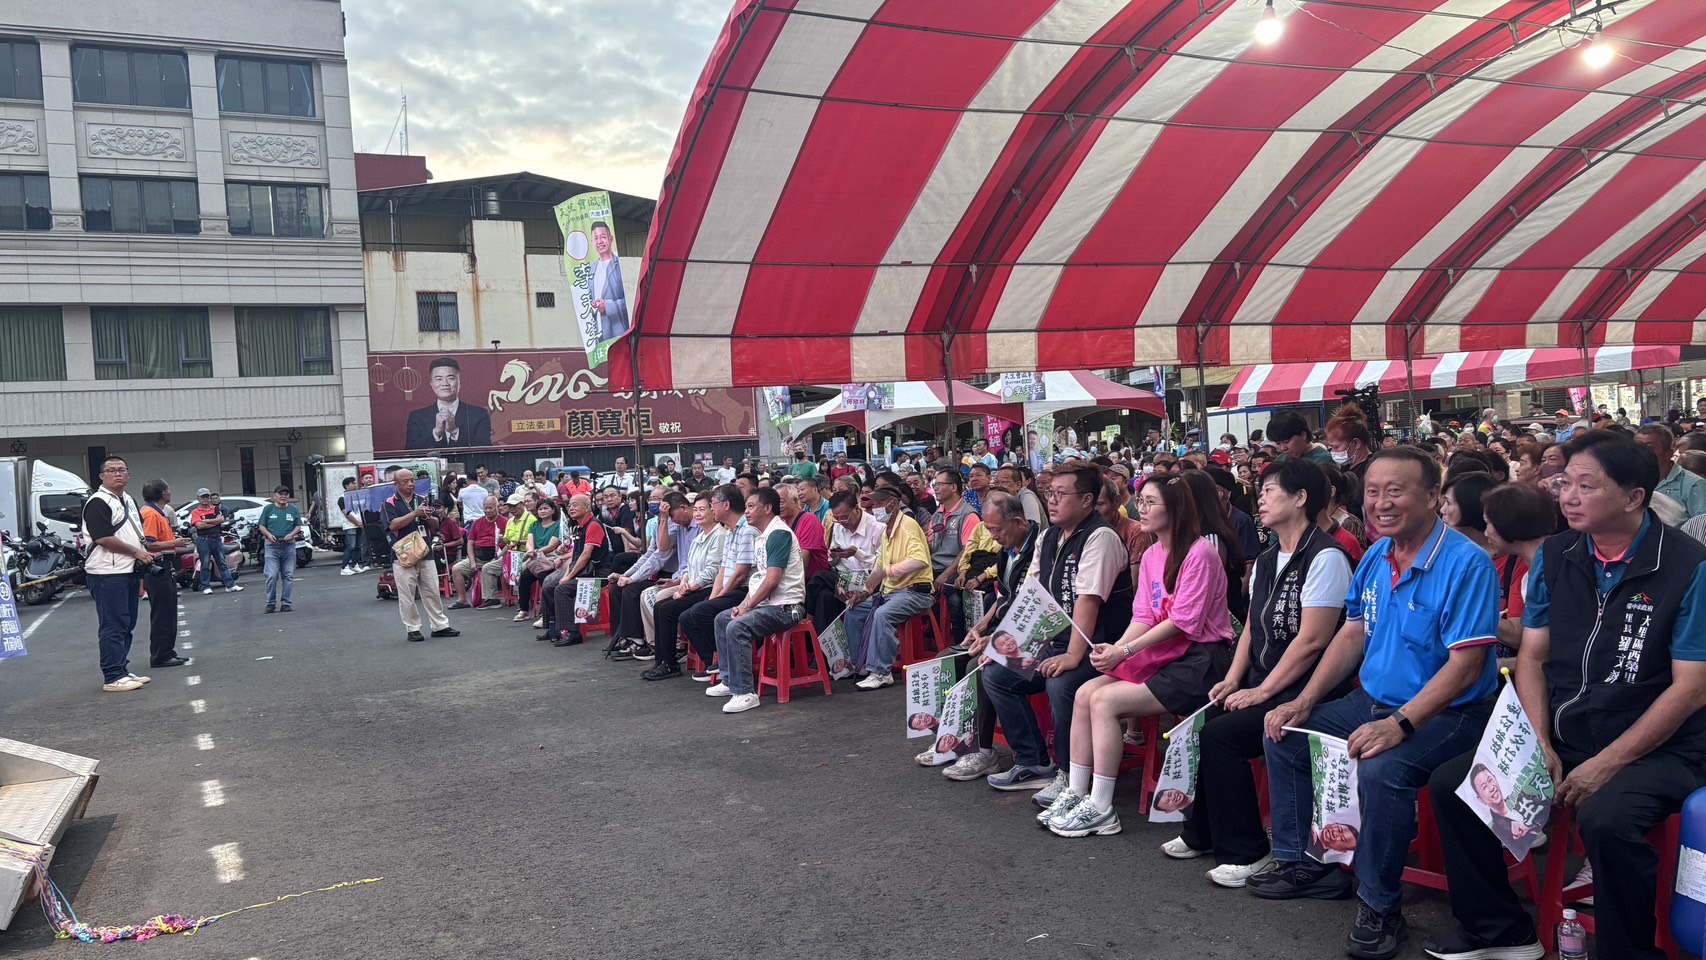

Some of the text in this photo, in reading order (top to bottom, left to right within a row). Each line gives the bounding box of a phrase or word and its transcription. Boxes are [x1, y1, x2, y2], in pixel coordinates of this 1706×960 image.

[573, 262, 603, 347] 李天生
[1013, 383, 1044, 397] 李天生
[516, 420, 556, 431] 立法委員
[658, 422, 682, 434] 敬祝
[1272, 584, 1290, 641] 里長黃秀玲
[1624, 615, 1652, 684] 大里區西榮里
[1337, 753, 1351, 809] 連任相挺
